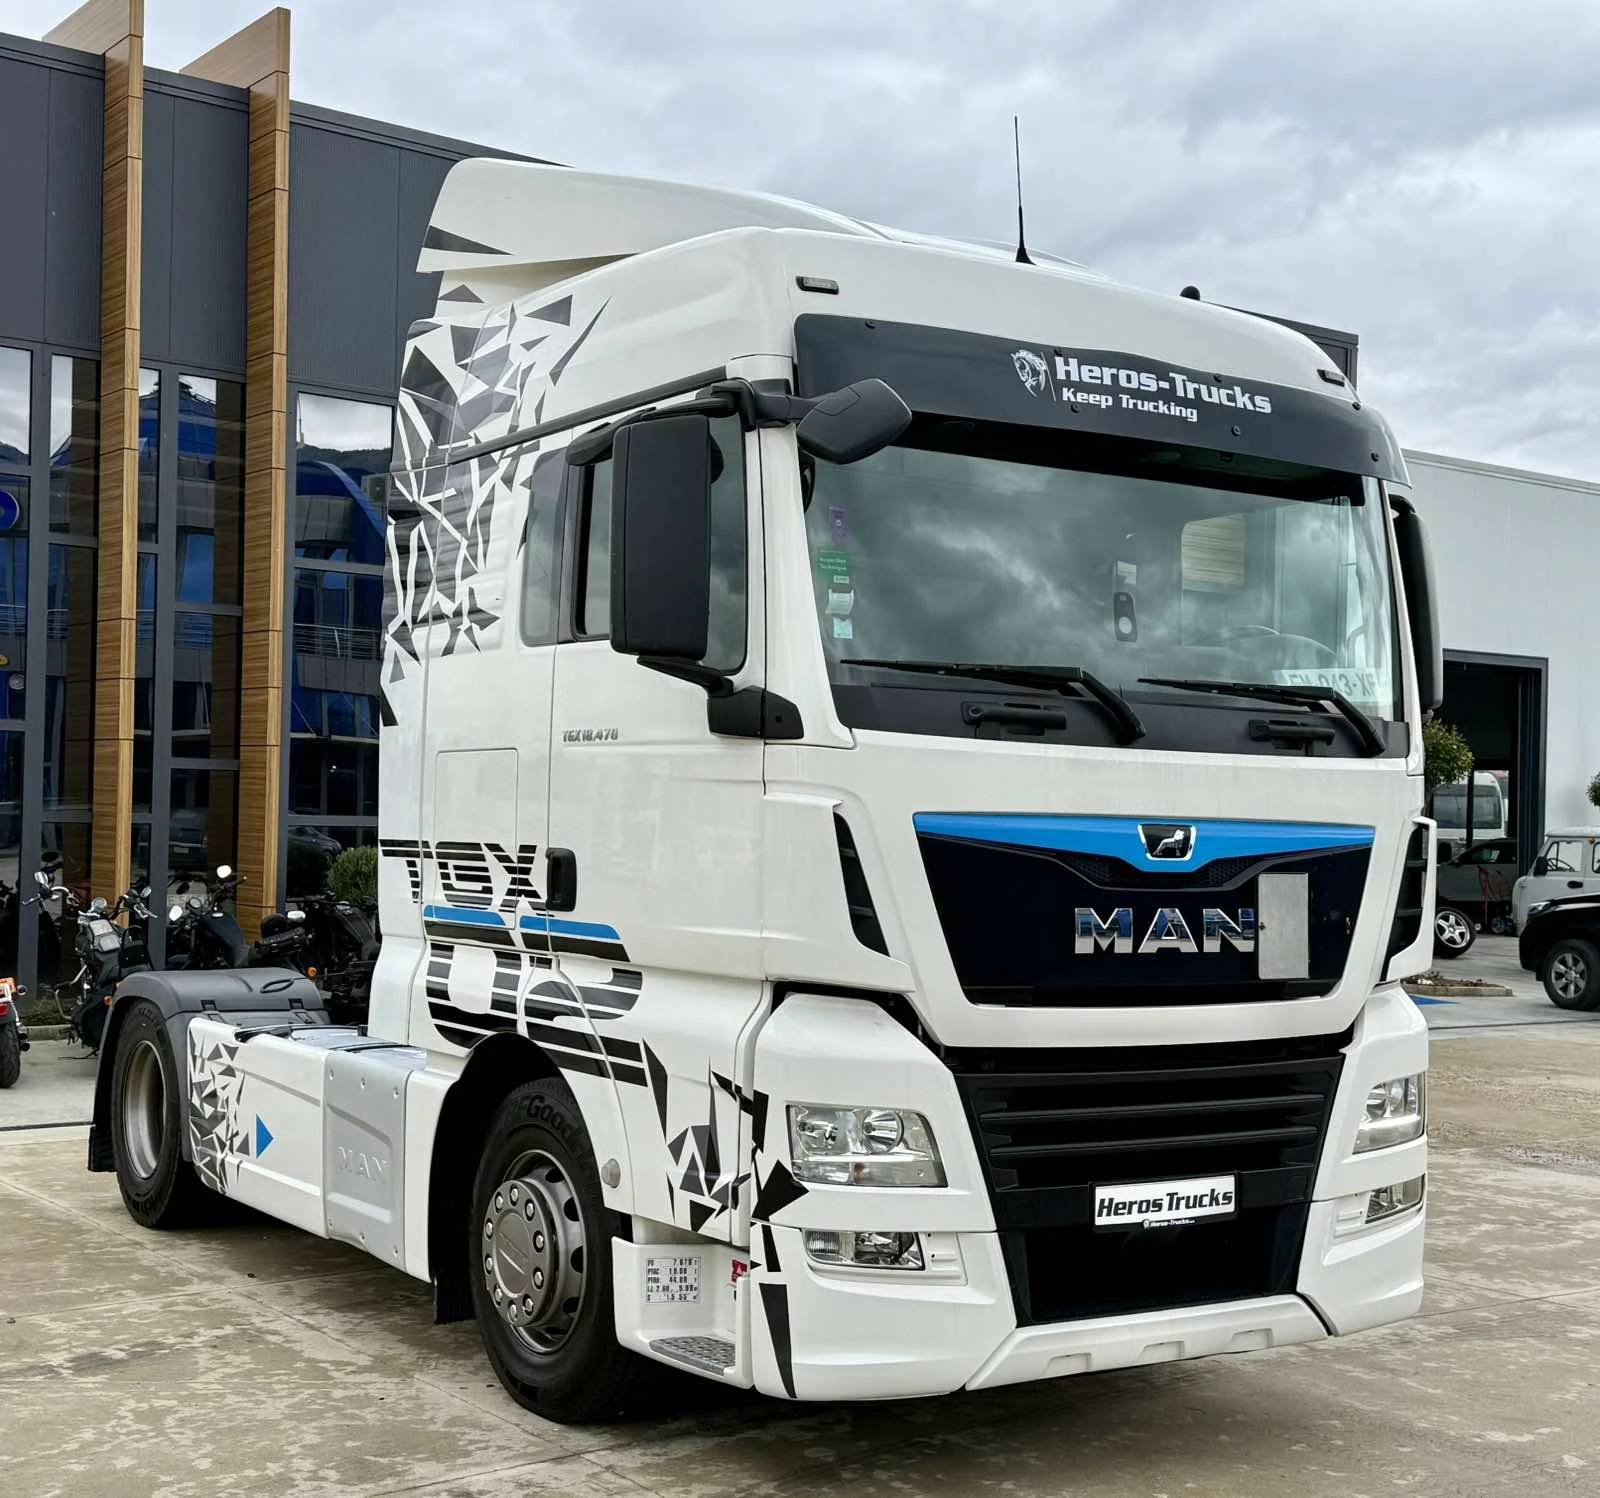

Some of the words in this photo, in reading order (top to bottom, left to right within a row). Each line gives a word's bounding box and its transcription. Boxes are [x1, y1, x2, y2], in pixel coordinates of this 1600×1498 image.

[1055, 356, 1272, 414] Heros-Trucks
[1062, 387, 1113, 408] Keep
[1119, 393, 1198, 422] Trucking
[379, 839, 553, 914] TGX
[1074, 907, 1256, 954] MAN
[1097, 1197, 1164, 1218] Heros
[1166, 1188, 1234, 1211] Trucks
